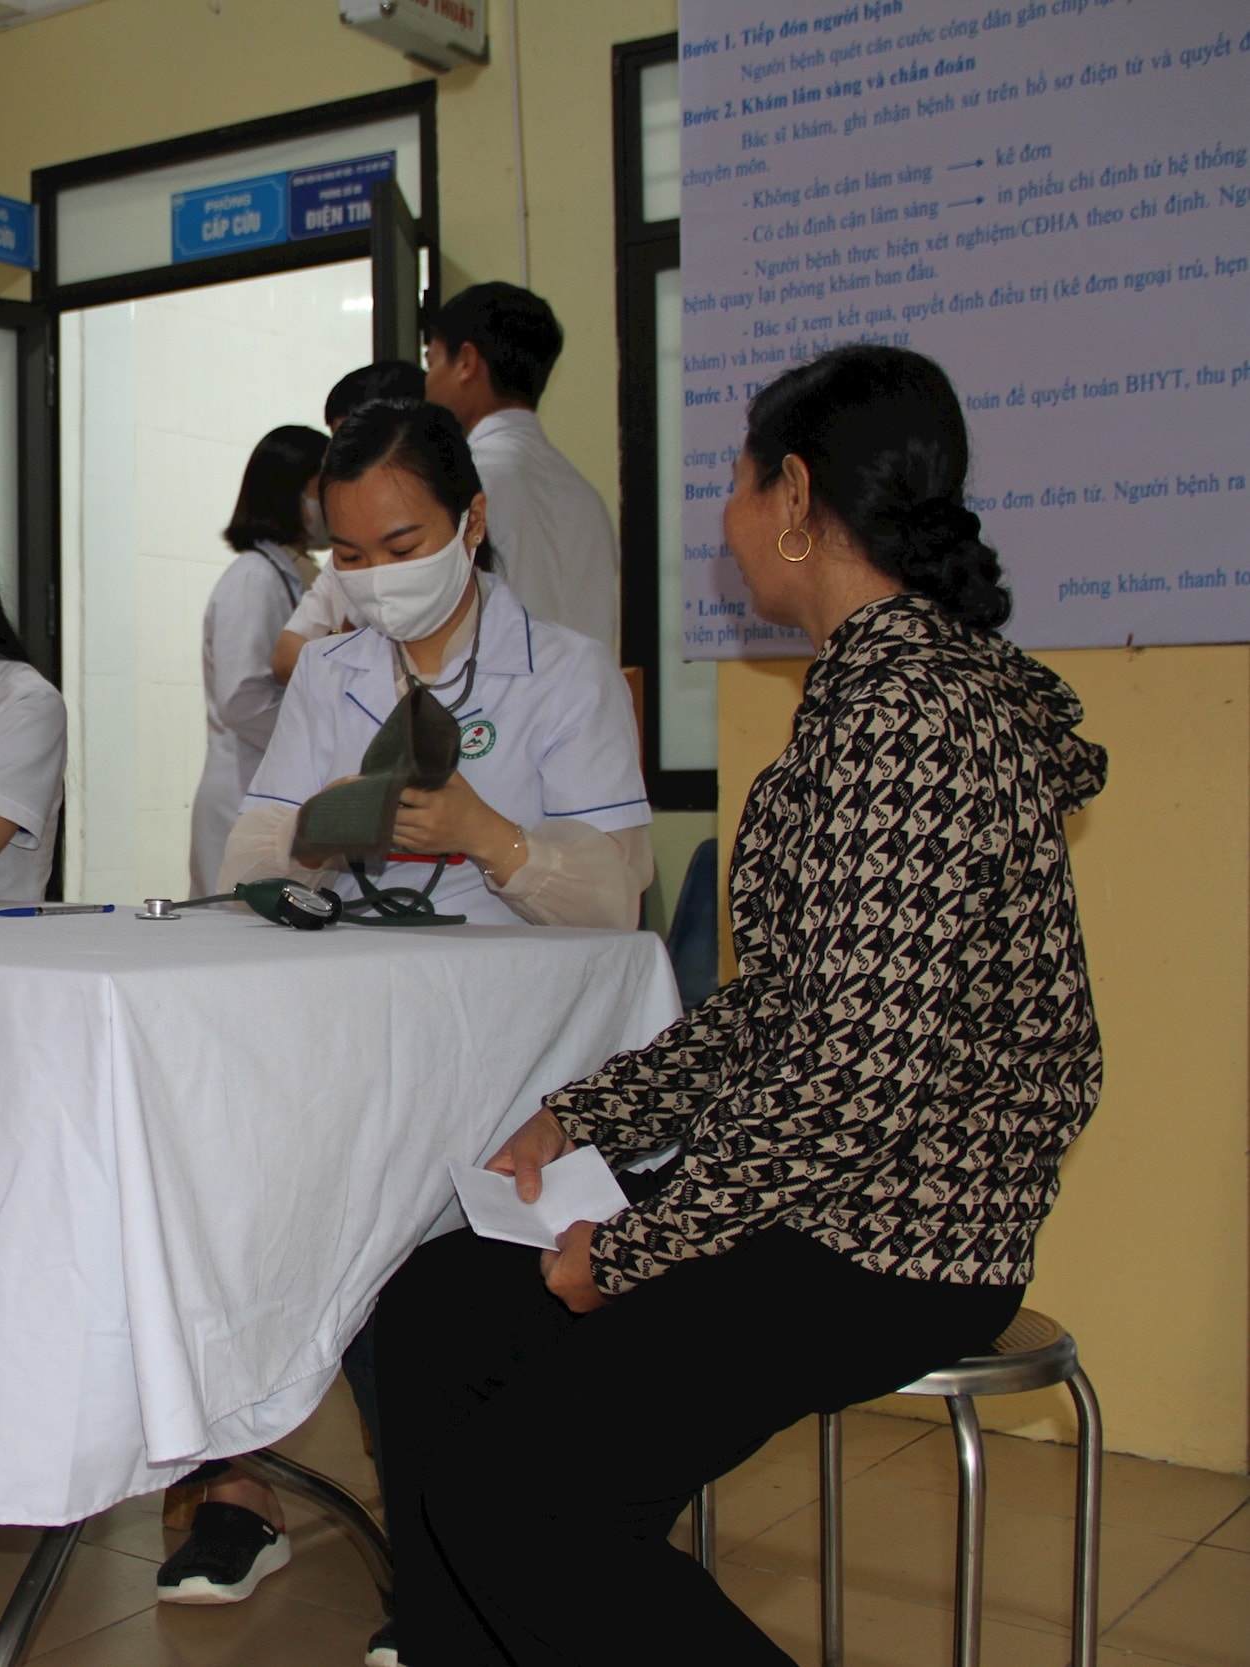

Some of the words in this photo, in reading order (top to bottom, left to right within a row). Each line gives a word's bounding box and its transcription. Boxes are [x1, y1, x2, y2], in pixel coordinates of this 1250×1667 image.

[683, 37, 719, 60] Bước
[725, 33, 736, 50] 1.
[742, 21, 775, 47] Tiếp
[780, 20, 808, 39] đón
[814, 7, 859, 34] người
[742, 57, 786, 82] Người
[790, 48, 825, 73] bệnh
[830, 41, 862, 67] quét
[897, 26, 935, 49] cước
[940, 18, 978, 39] công
[683, 105, 719, 128] Bước
[724, 101, 737, 119] 2.
[742, 94, 788, 116] Khám
[792, 86, 822, 105] lâm
[826, 79, 862, 98] sàng
[866, 71, 886, 90] và
[934, 54, 976, 78] đoán
[742, 130, 768, 150] Bác
[844, 107, 867, 136] ghi
[873, 103, 911, 126] nhận
[917, 93, 955, 118] bệnh
[987, 81, 1020, 104] trên
[1054, 73, 1074, 91] sơ
[1080, 61, 1118, 86] điện
[1152, 49, 1172, 69] và
[1180, 31, 1232, 69] quyết
[682, 163, 731, 187] chuyên
[753, 187, 801, 209] Không
[834, 175, 860, 197] cận
[865, 170, 892, 190] lâm
[897, 164, 933, 185] sàng
[1019, 143, 1052, 163] đơn
[753, 223, 774, 244] Có
[803, 215, 836, 238] định
[840, 210, 866, 233] cận
[870, 205, 898, 225] lâm
[903, 200, 939, 220] sàng
[998, 185, 1013, 204] in
[1018, 170, 1064, 207] phiếu
[1100, 163, 1138, 188] định
[1168, 152, 1189, 177] hệ
[1195, 141, 1247, 170] thống
[755, 257, 800, 281] Người
[806, 248, 841, 273] bệnh
[848, 245, 881, 264] thực
[887, 236, 920, 259] hiện
[926, 231, 949, 252] xét
[1087, 206, 1124, 227] theo
[684, 293, 716, 314] bệnh
[720, 293, 754, 311] quay
[759, 286, 776, 306] lại
[830, 273, 870, 294] khám
[875, 268, 902, 287] ban
[753, 318, 779, 338] Bác
[802, 315, 832, 331] xem
[838, 304, 861, 328] kết
[902, 290, 945, 323] quyết
[949, 290, 985, 314] định
[1030, 280, 1048, 304] trị
[1085, 273, 1118, 294] đơn
[1124, 263, 1172, 293] ngoại
[1215, 255, 1248, 278] hẹn
[684, 353, 727, 373] khám)
[731, 349, 747, 366] và
[790, 337, 808, 360] tất
[685, 386, 721, 407] Bước
[726, 384, 739, 401] 3.
[1031, 376, 1076, 408] quyết
[1083, 378, 1119, 399] toán
[1196, 365, 1225, 387] thu
[685, 482, 722, 501] Bước
[1003, 490, 1033, 510] đơn
[1041, 486, 1076, 507] điện
[1114, 476, 1168, 504] Người
[1176, 473, 1219, 495] bệnh
[1227, 475, 1245, 492] ra
[1058, 576, 1111, 601] phòng
[1178, 567, 1226, 590] thanh
[685, 626, 713, 646] viện
[744, 620, 774, 644] phát
